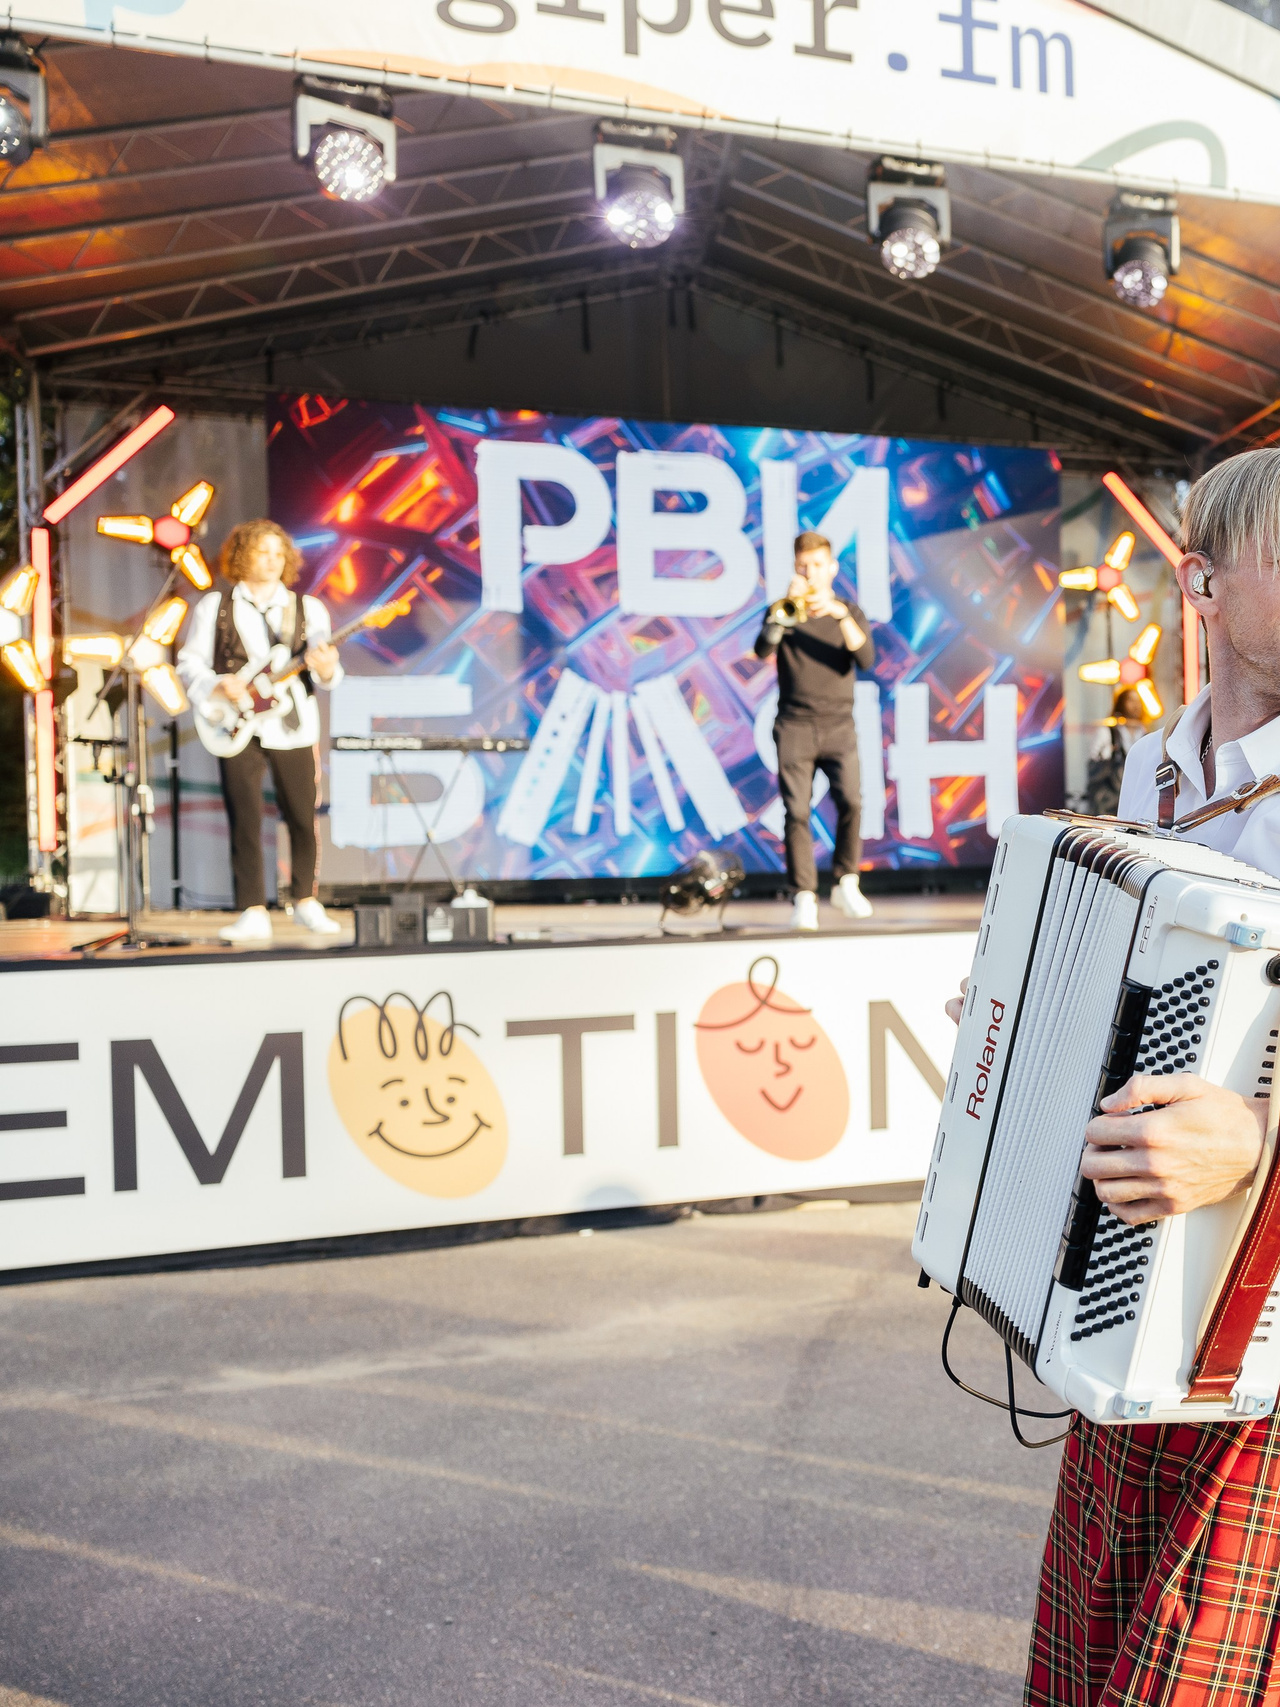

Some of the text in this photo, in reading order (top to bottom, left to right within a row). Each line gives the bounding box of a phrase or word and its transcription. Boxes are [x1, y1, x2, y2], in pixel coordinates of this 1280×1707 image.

[436, 0, 1076, 98] per.fm
[476, 439, 893, 624] РВИ
[966, 998, 1005, 1120] Roland
